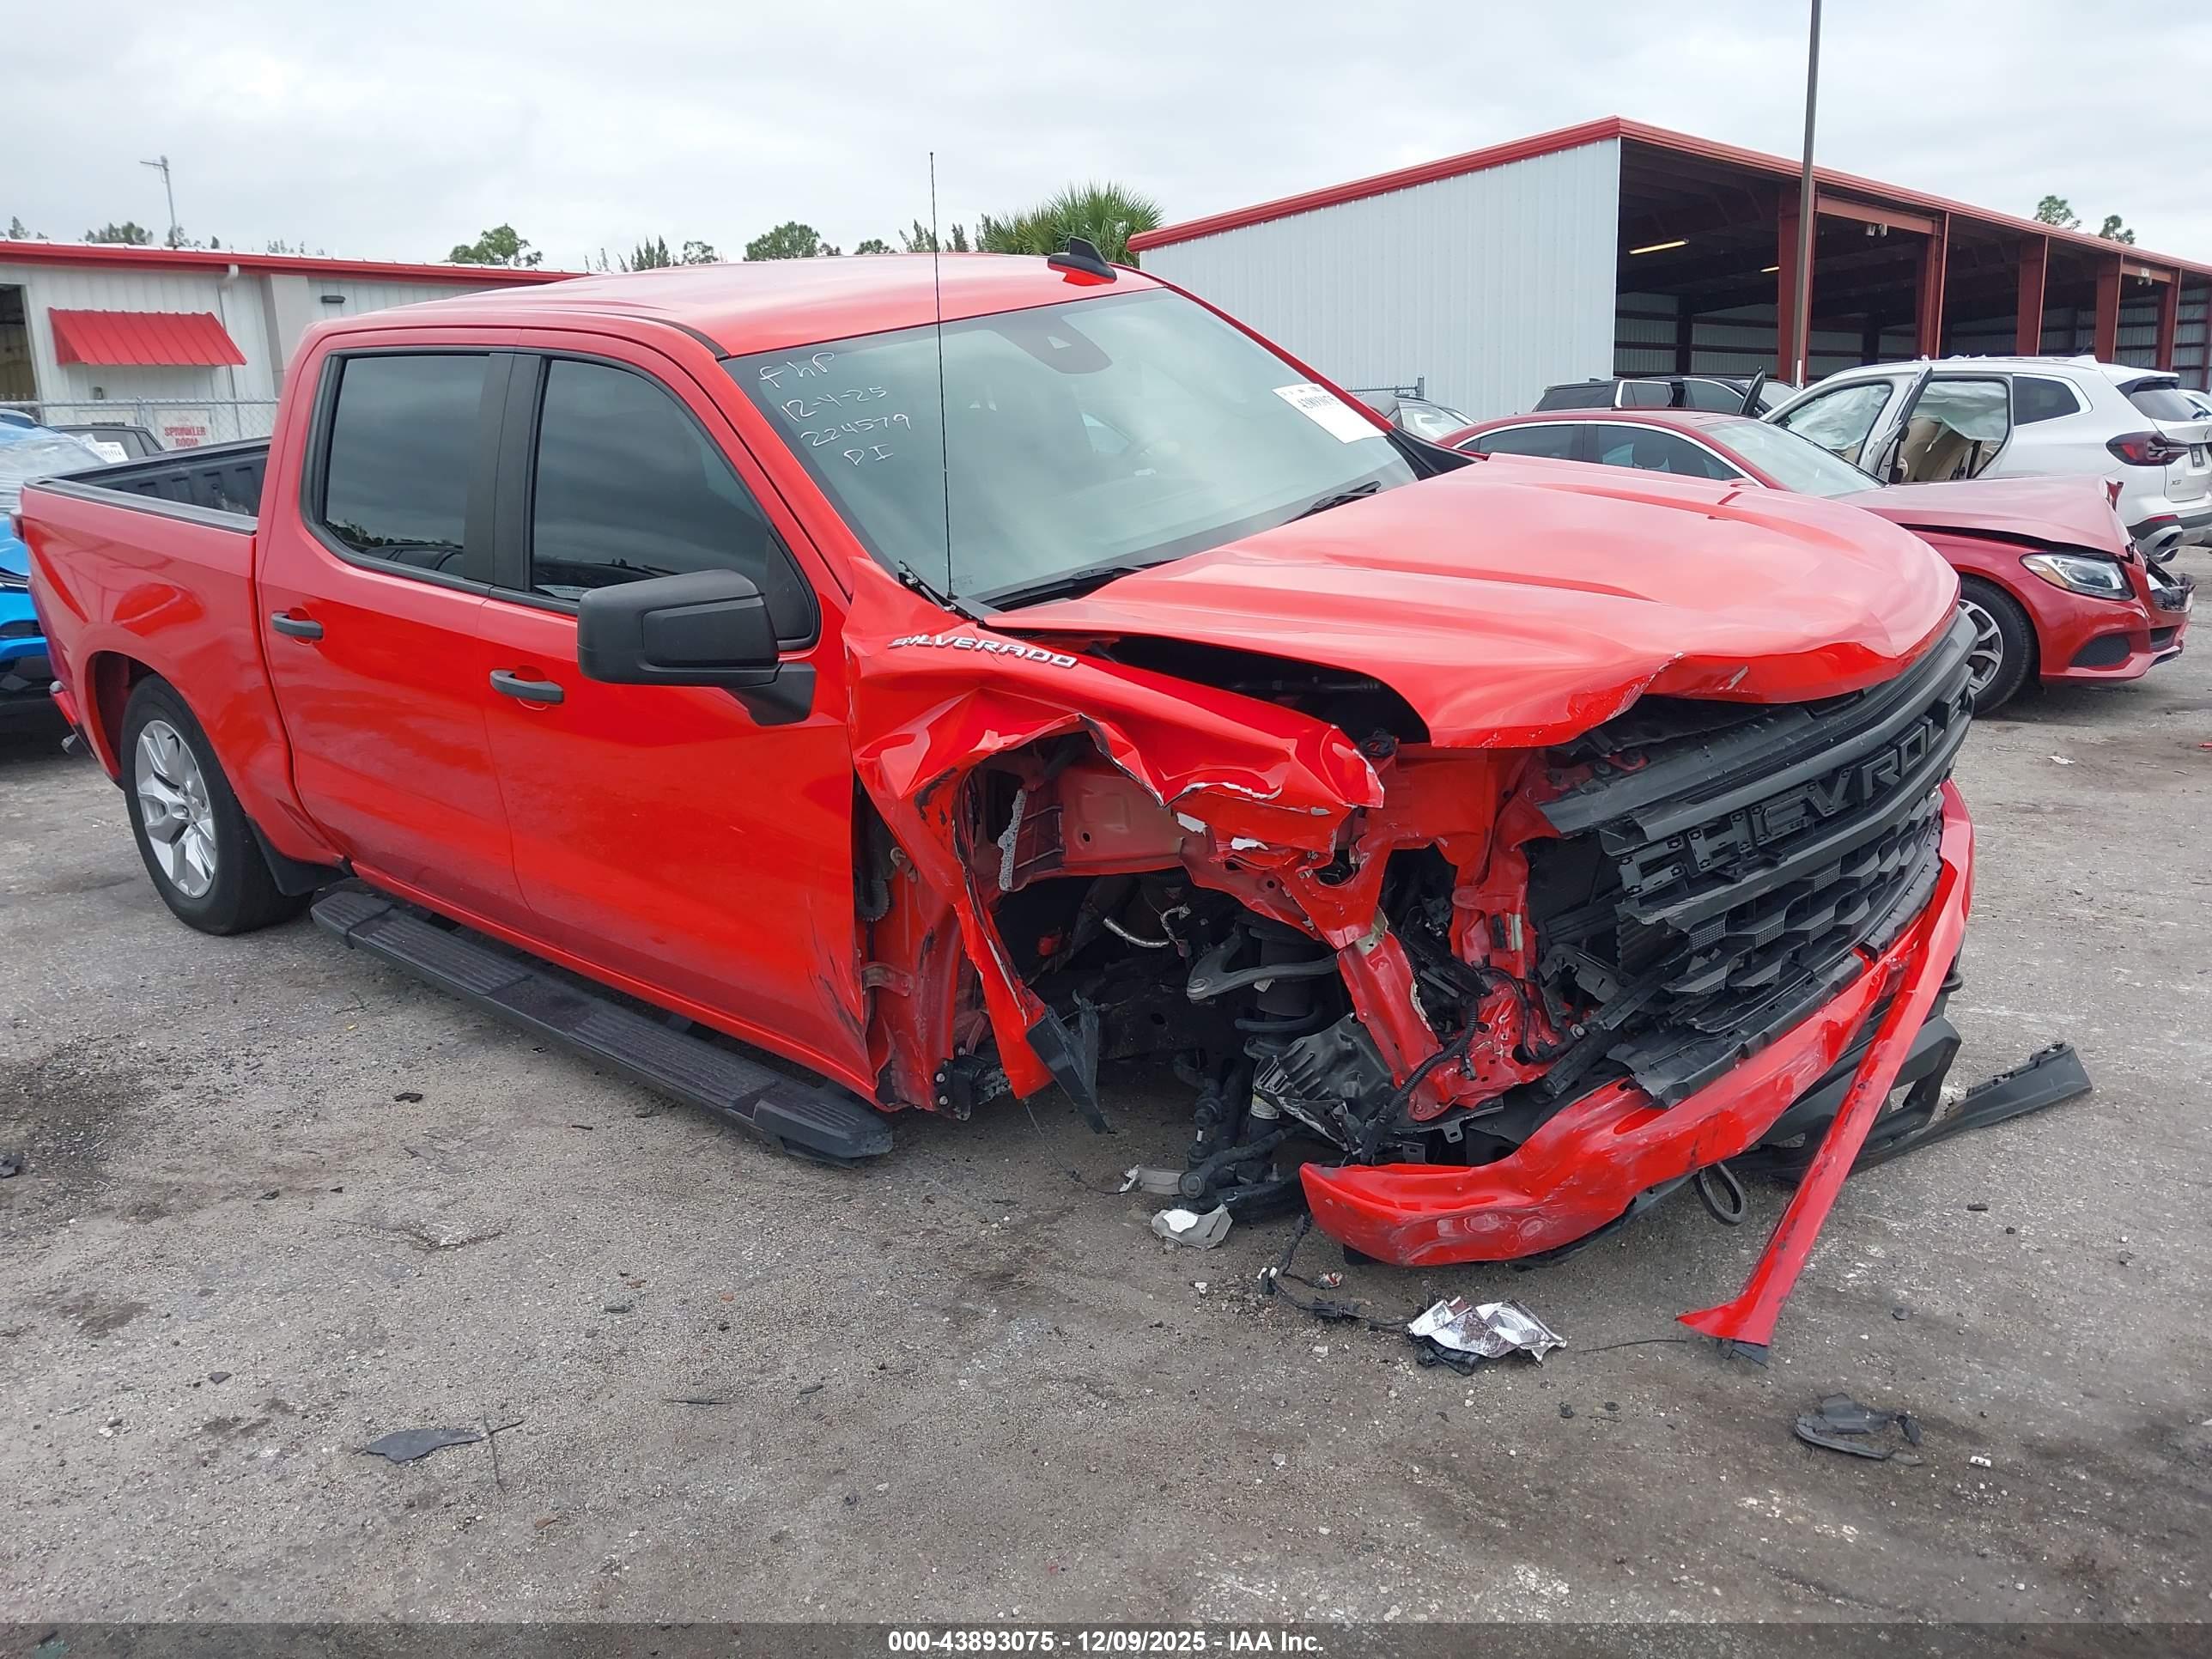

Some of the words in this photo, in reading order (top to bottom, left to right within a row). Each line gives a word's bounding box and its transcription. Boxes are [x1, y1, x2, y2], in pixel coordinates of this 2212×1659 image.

[781, 386, 887, 422] 12-4-25
[164, 426, 207, 436] SPRINKLER
[175, 437, 199, 447] ROOM
[800, 414, 911, 447] 224579
[888, 634, 1079, 669] SILVERADO
